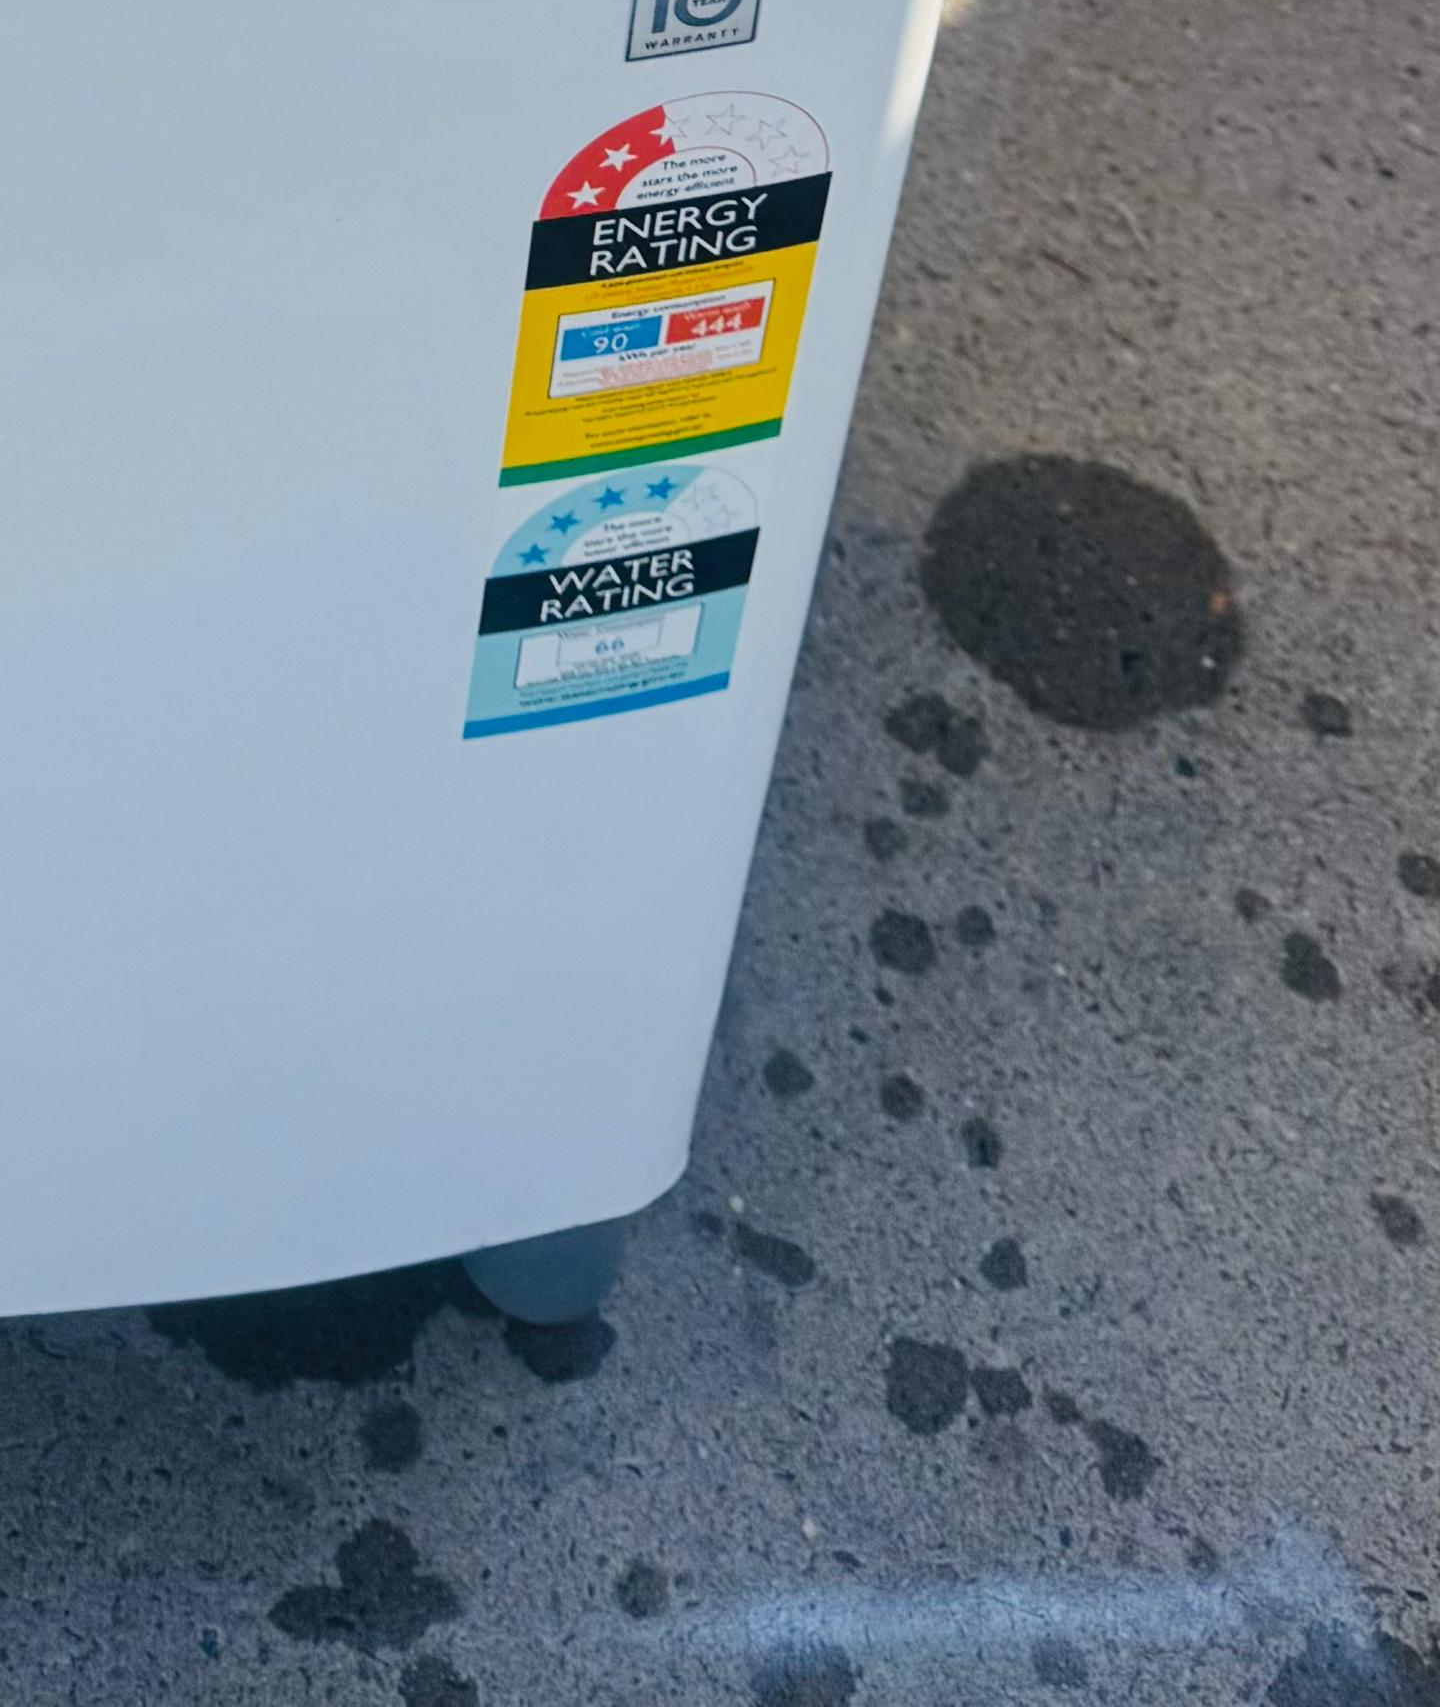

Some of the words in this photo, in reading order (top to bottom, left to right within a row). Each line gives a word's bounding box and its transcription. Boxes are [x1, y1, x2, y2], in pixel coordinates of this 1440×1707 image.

[645, 27, 739, 50] WARRANTY
[662, 160, 686, 171] The
[677, 172, 698, 183] the
[636, 186, 680, 200] energy
[684, 177, 736, 193] efficient
[592, 192, 769, 247] ENERGY
[589, 225, 758, 277] RATING
[691, 313, 743, 338] 444
[593, 333, 628, 354] 90
[548, 548, 695, 596] WATER
[540, 572, 695, 624] RATING
